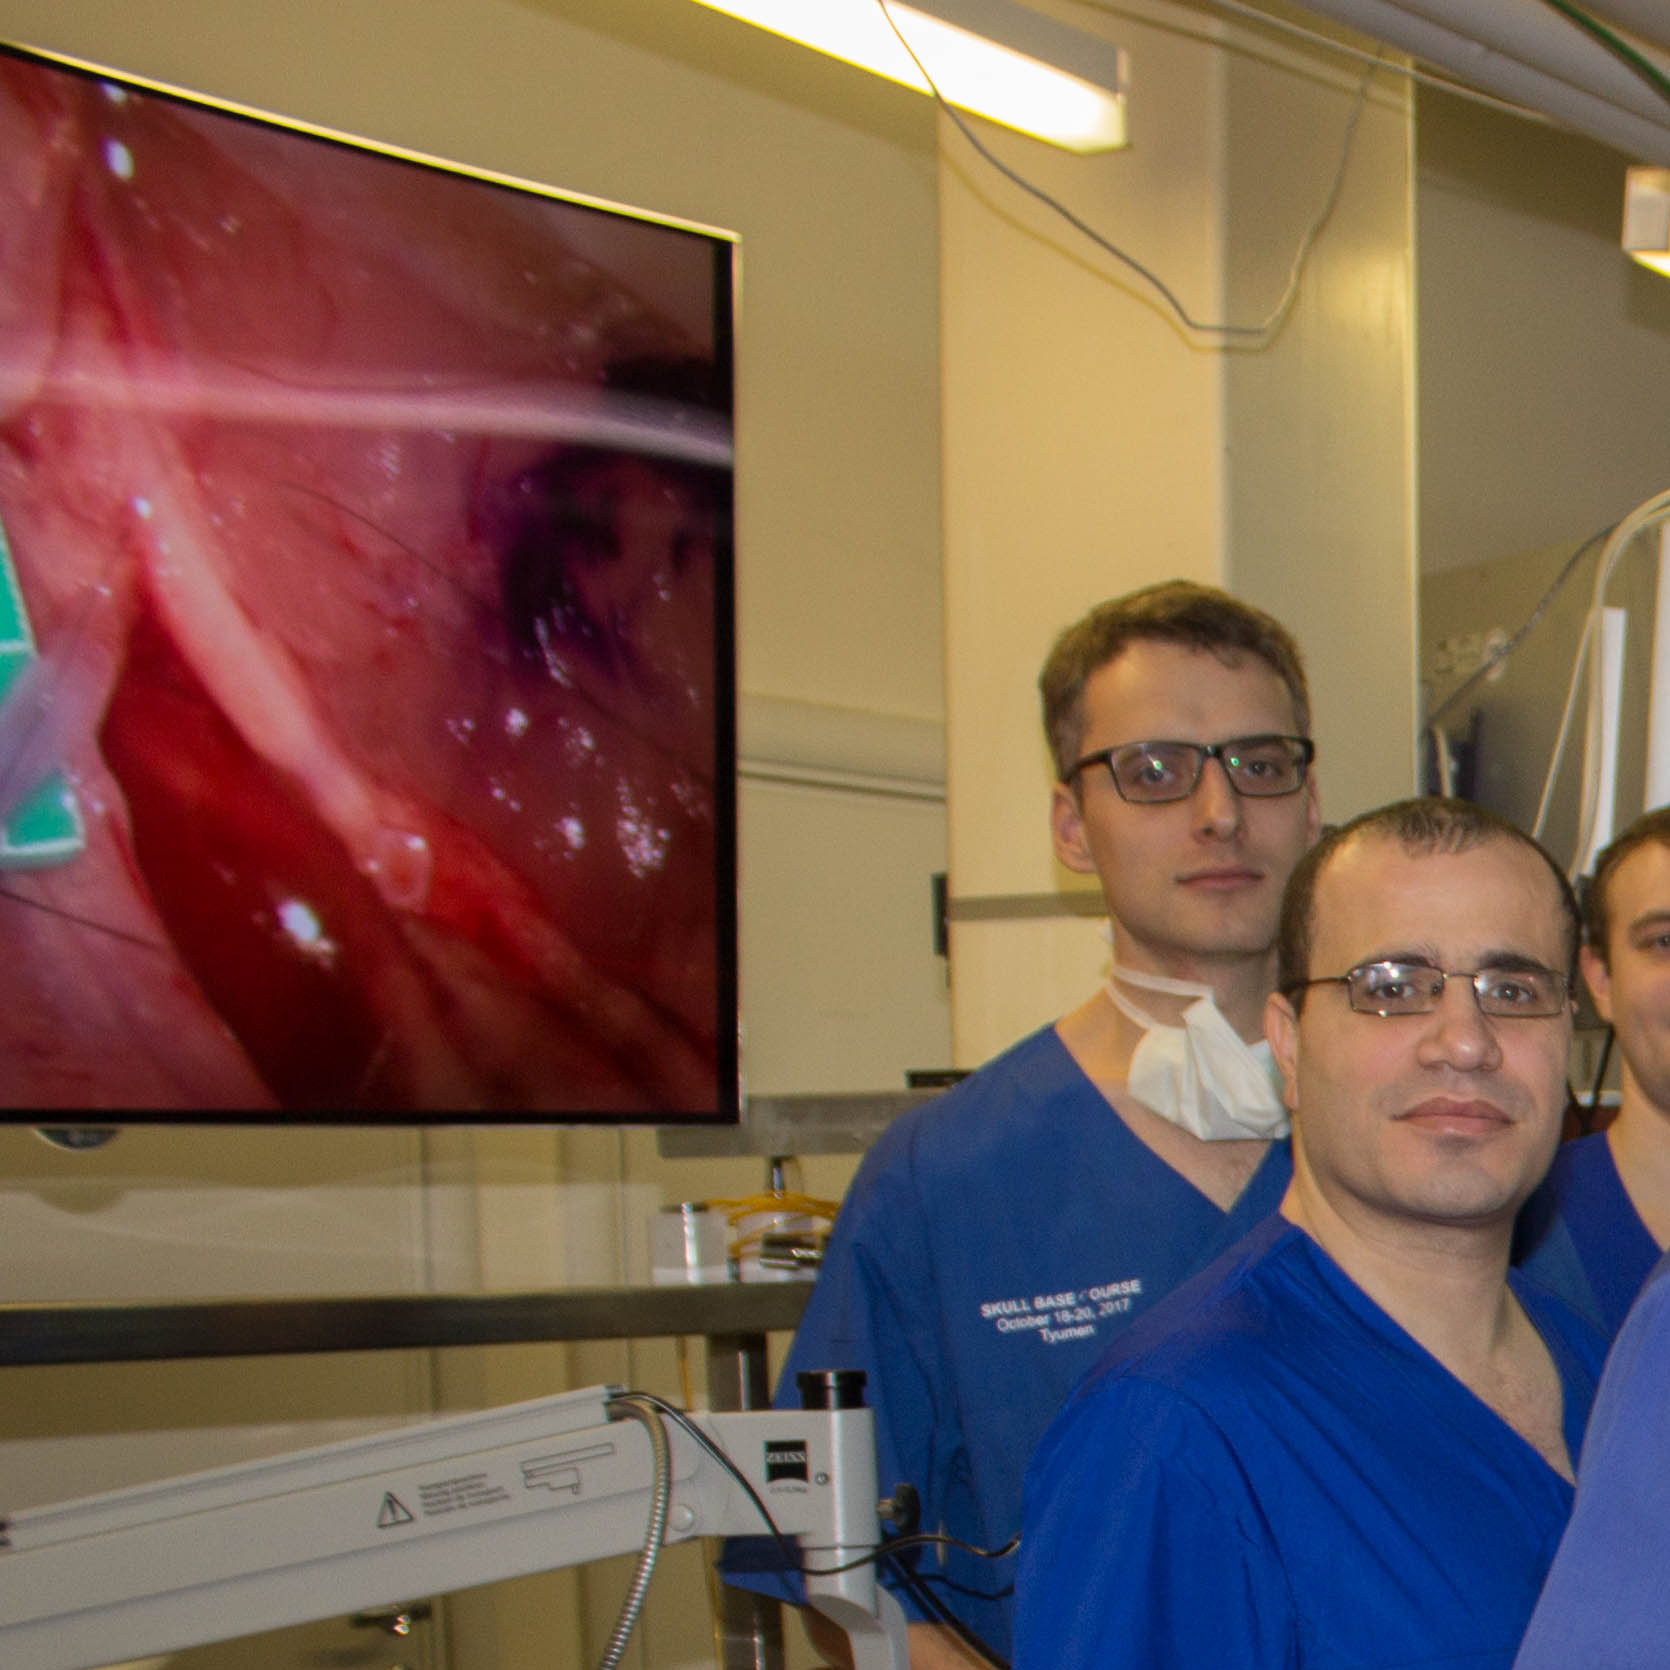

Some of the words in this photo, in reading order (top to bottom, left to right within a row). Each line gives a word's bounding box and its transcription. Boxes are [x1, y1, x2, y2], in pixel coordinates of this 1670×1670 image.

[980, 1297, 1031, 1319] SKULL
[1033, 1291, 1075, 1310] BASE
[996, 1313, 1049, 1333] October
[1098, 1298, 1130, 1317] 2017
[1039, 1324, 1095, 1344] Tyumen
[767, 1451, 806, 1464] ZEISS
